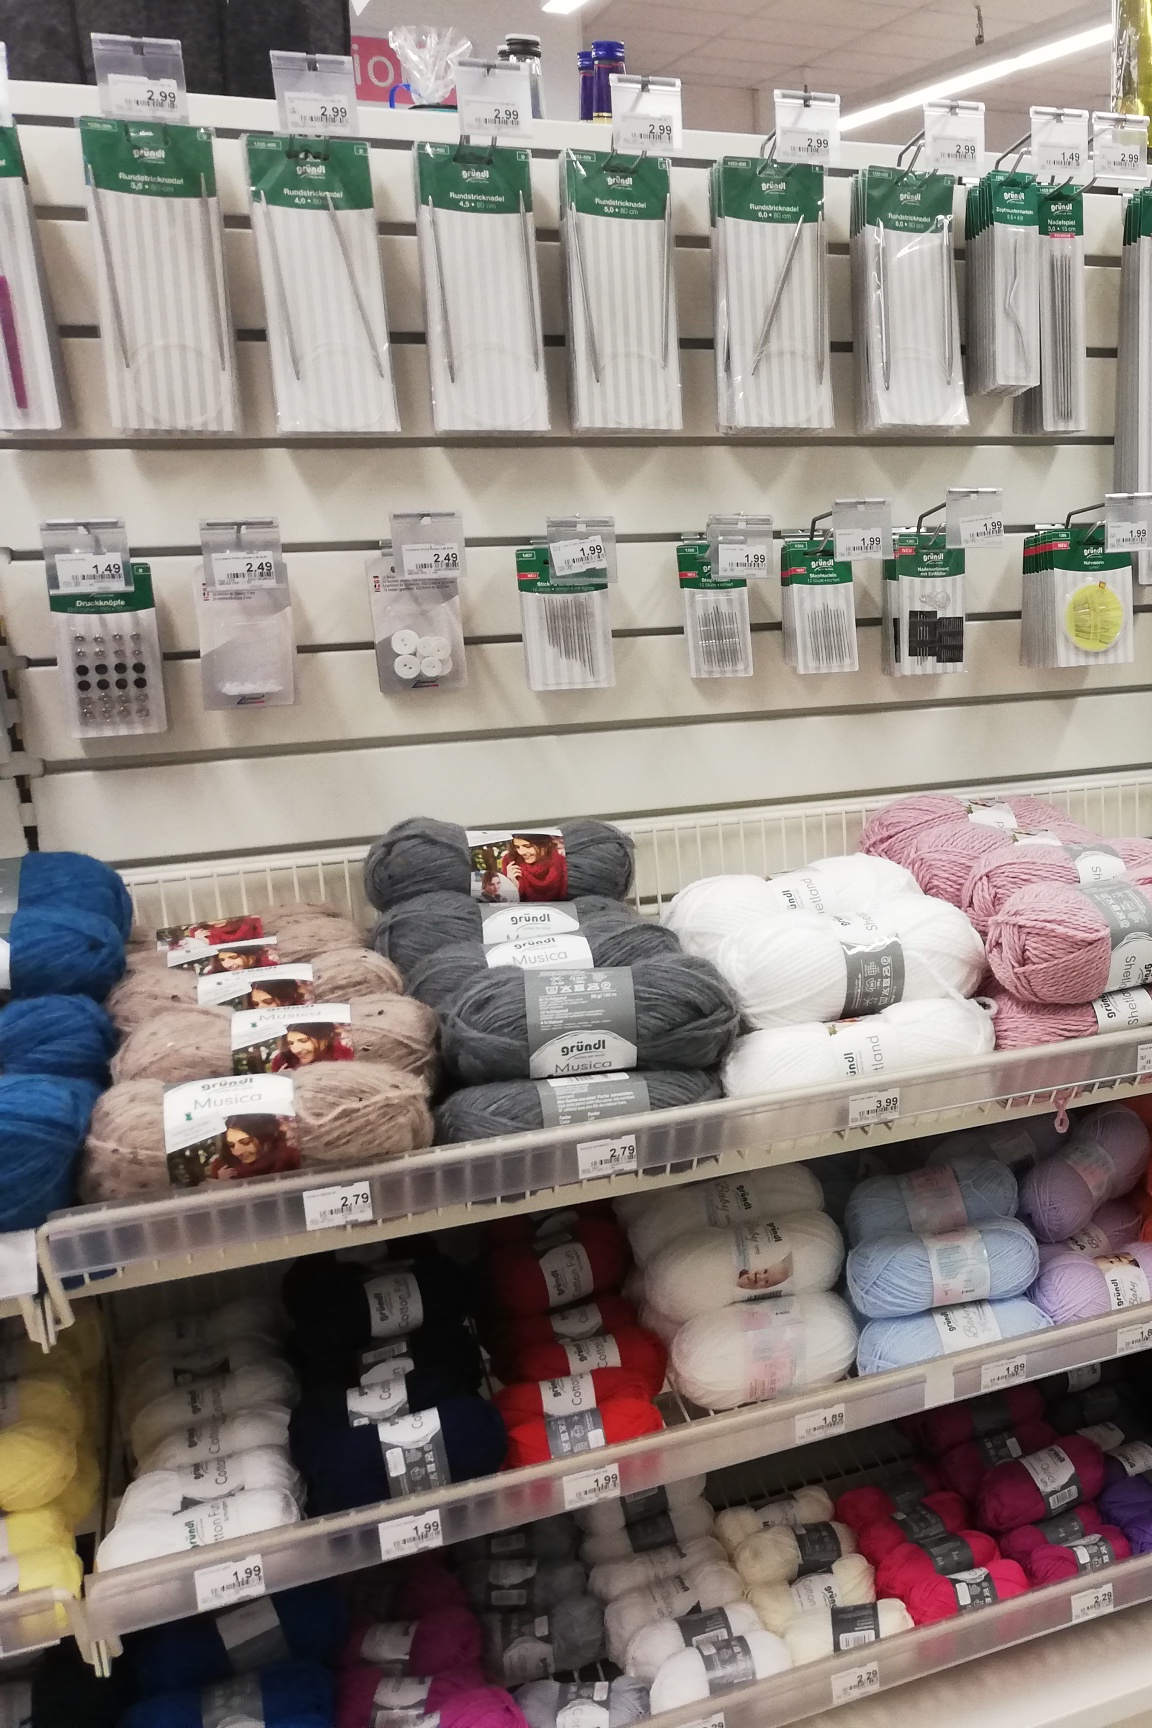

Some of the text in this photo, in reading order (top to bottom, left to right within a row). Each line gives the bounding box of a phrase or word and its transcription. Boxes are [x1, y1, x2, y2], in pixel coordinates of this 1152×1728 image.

[147, 89, 176, 103] 2.99
[320, 106, 348, 118] 2.99
[494, 109, 518, 120] 2.99
[649, 124, 672, 134] 2.99
[807, 138, 828, 148] 2.99
[956, 144, 976, 154] 2.99
[133, 147, 165, 159] gründl
[1061, 152, 1080, 162] 1.49
[1121, 153, 1139, 163] 2.99
[296, 164, 325, 175] gründl
[462, 170, 489, 180] gründl
[607, 176, 633, 186] gründl
[761, 181, 786, 191] gründl
[450, 192, 504, 202] Rundstricknadel
[900, 193, 921, 202] gründl
[1003, 191, 1025, 202] gründl
[595, 198, 646, 208] Rundstricknadel
[750, 203, 799, 212] Rundstricknadel
[1051, 202, 1072, 212] gründl
[983, 521, 1002, 532] 1.99
[1129, 528, 1147, 538] 1.99
[861, 537, 881, 547] 1.99
[579, 544, 602, 558] 1.99
[1084, 548, 1103, 557] gründl
[433, 552, 459, 564] 2.49
[744, 554, 766, 563] 1.99
[923, 553, 944, 563] gründl
[92, 562, 121, 575] 1.49
[245, 561, 273, 573] 2.49
[811, 560, 834, 569] gründl
[76, 599, 125, 608] Druckknöpfe
[510, 913, 551, 925] gründl
[513, 937, 556, 950] gründl
[512, 950, 568, 966] Musica
[561, 1039, 606, 1056] gründl
[866, 1034, 884, 1071] tland
[555, 1060, 612, 1073] Musica
[844, 1052, 857, 1075] ündl
[201, 1077, 253, 1091] gründl
[193, 1092, 262, 1110] Musica
[876, 1096, 898, 1109] 3.99
[610, 1145, 635, 1158] 2.79
[341, 1192, 369, 1207] 2.79
[736, 1184, 752, 1210] gründl
[766, 1222, 783, 1243] gründl
[550, 1269, 566, 1297] gründl
[1111, 1278, 1124, 1307] gründl
[374, 1291, 389, 1322] gründl
[937, 1310, 957, 1332] gründl
[1005, 1363, 1025, 1375] 1.89
[823, 1412, 844, 1425] 1.89
[593, 1473, 618, 1488] 1.99
[412, 1521, 439, 1534] 1.99
[233, 1565, 261, 1581] 1.99
[1094, 1591, 1112, 1604] 2.29
[857, 1670, 878, 1684] 2.29
